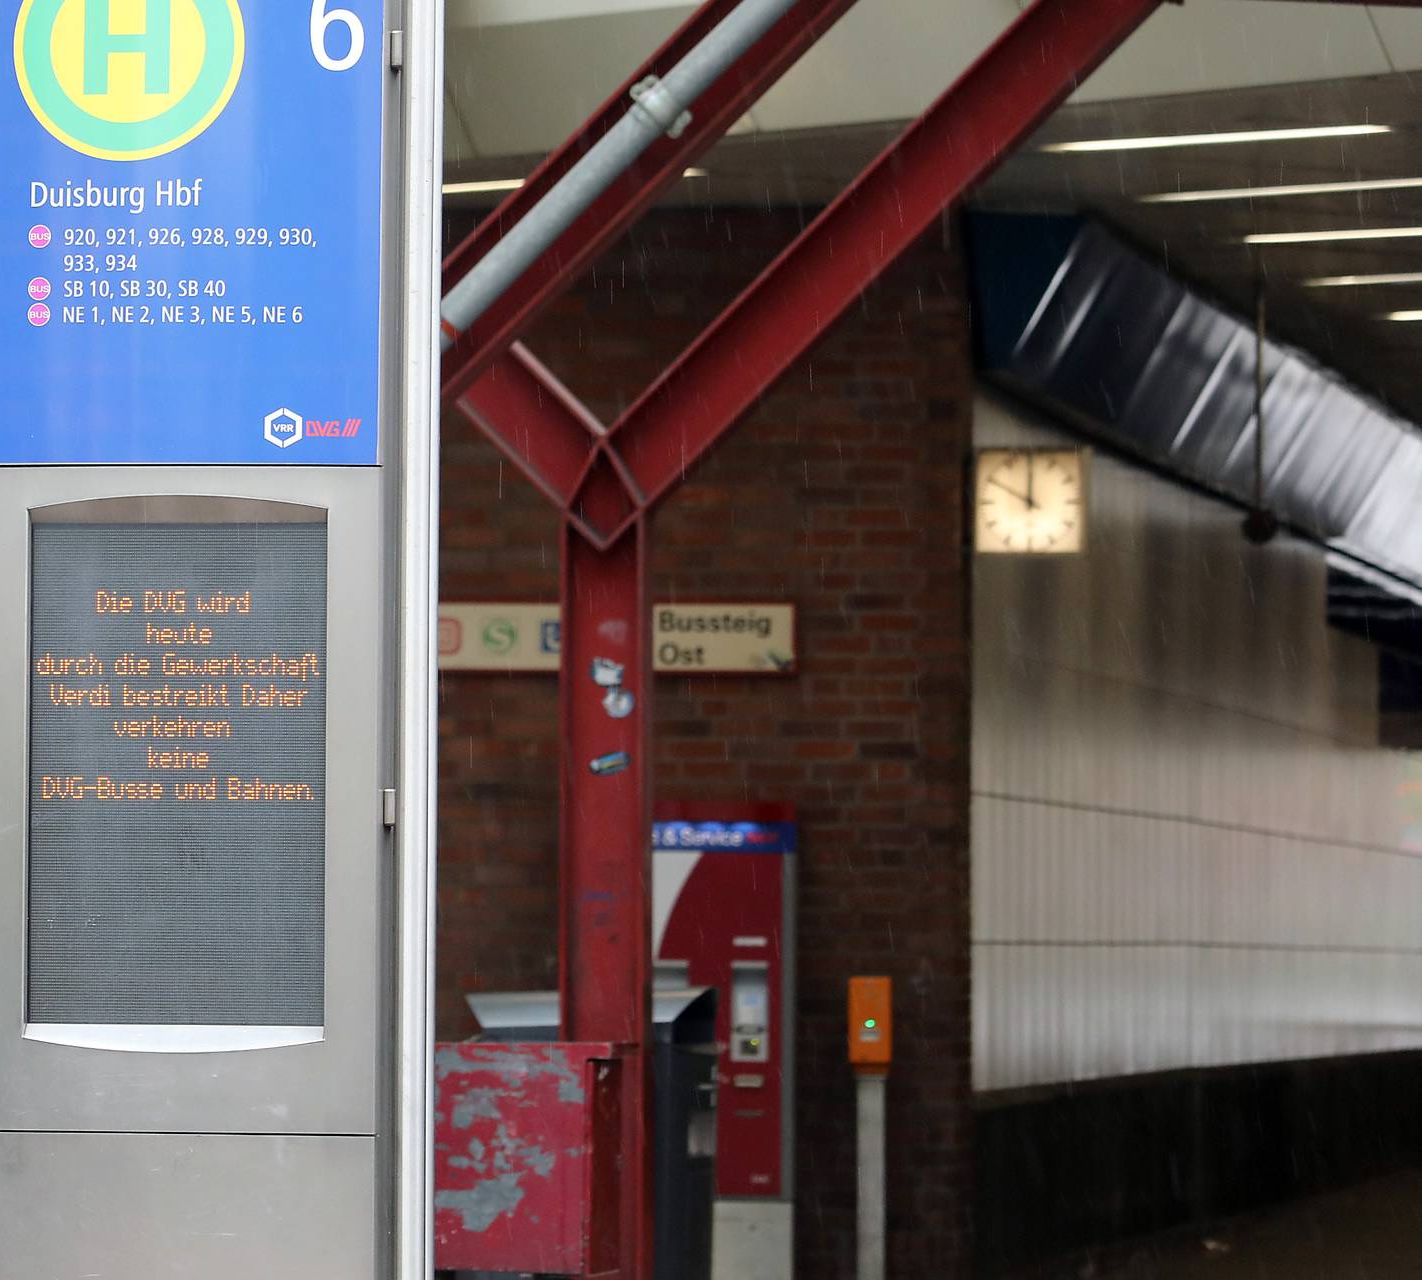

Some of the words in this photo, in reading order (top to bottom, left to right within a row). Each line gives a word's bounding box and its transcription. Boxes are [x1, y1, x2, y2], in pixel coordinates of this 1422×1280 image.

[310, 0, 365, 71] 6
[83, 0, 170, 95] H
[30, 180, 145, 214] Duisburg
[155, 178, 203, 208] Hbf
[29, 232, 50, 242] BUS
[63, 228, 100, 248] 920,
[105, 228, 142, 248] 921,
[148, 228, 186, 248] 926,
[191, 228, 229, 247] 928,
[234, 228, 273, 247] 929,
[278, 228, 317, 247] 930,
[63, 254, 99, 274] 933,
[105, 254, 138, 272] 934
[29, 284, 50, 294] BUS
[63, 280, 83, 298] SB
[90, 280, 115, 299] 10,
[120, 280, 140, 297] SB
[145, 280, 172, 299] 30,
[178, 280, 198, 297] SB
[203, 280, 226, 297] 40
[29, 310, 50, 320] BUS
[62, 306, 85, 323] NE
[91, 306, 105, 326] 1,
[111, 306, 134, 323] NE
[139, 306, 155, 325] 2,
[161, 306, 184, 323] NE
[189, 306, 206, 325] 3,
[212, 306, 235, 323] NE
[240, 306, 256, 325] 5,
[262, 306, 286, 323] NE
[291, 306, 303, 323] 6
[273, 423, 294, 433] VRR
[96, 590, 133, 613] Die
[144, 590, 186, 613] DVG
[196, 590, 251, 613] wird
[146, 622, 213, 644] heute
[658, 611, 772, 638] Bussteig
[658, 645, 705, 665] Ost
[36, 652, 103, 675] durch
[114, 652, 151, 675] die
[162, 652, 320, 682] Gewerkschaft
[49, 683, 112, 706] Verdi
[123, 683, 230, 706] bestreikt
[241, 684, 309, 706] Daher
[113, 715, 233, 737] verkehren
[147, 746, 210, 769] keine
[41, 776, 164, 799] DVG-Busse
[174, 777, 217, 800] und
[227, 777, 315, 800] Bahnen.
[679, 827, 745, 847] Service
